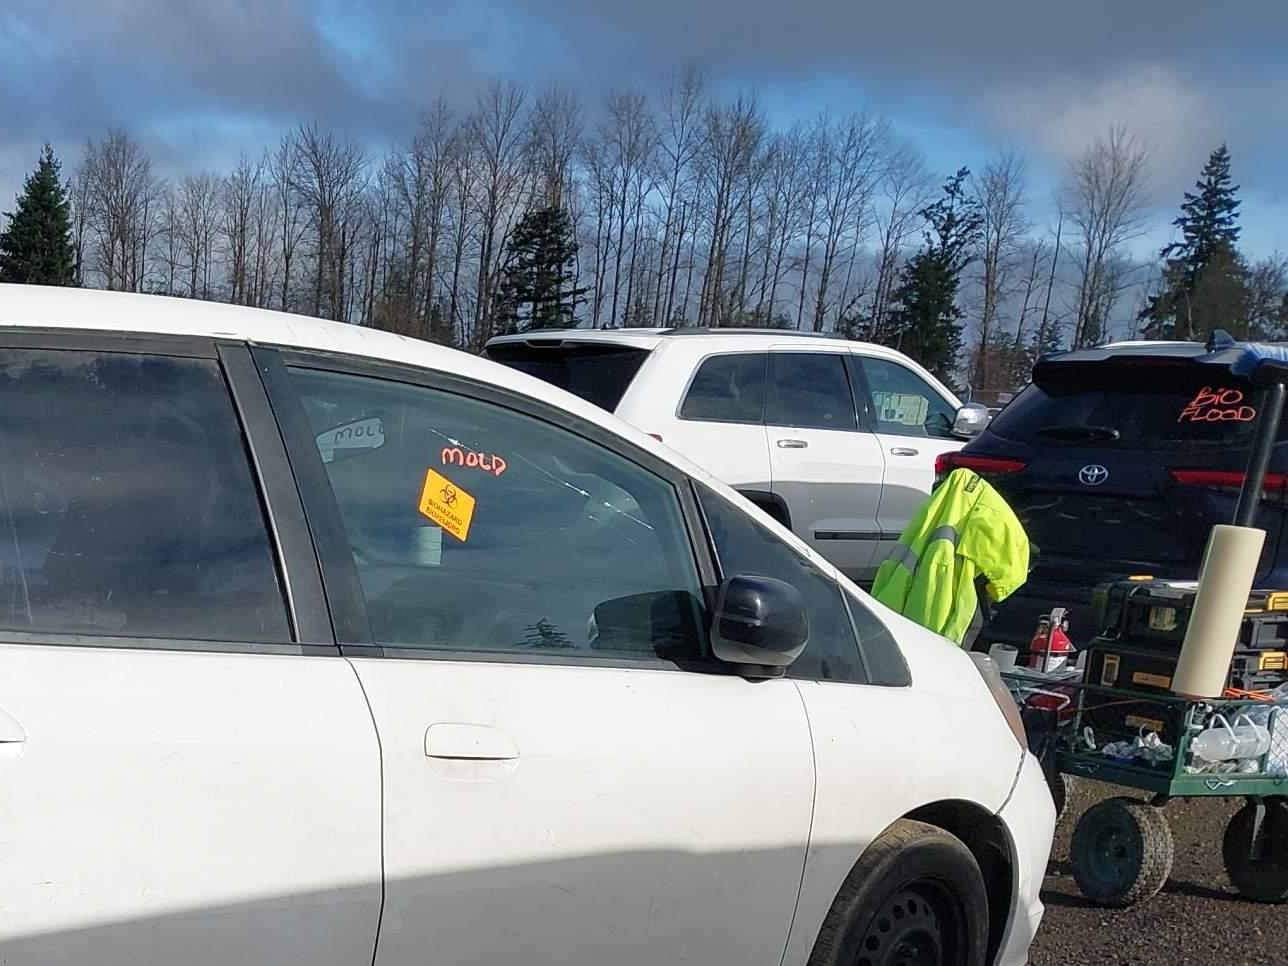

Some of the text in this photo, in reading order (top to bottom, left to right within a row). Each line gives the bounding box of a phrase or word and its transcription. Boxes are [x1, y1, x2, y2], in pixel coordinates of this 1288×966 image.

[1177, 405, 1257, 423] FLOOD
[426, 507, 461, 534] BIOPELIGRO
[428, 499, 463, 525] BIOHAZARD
